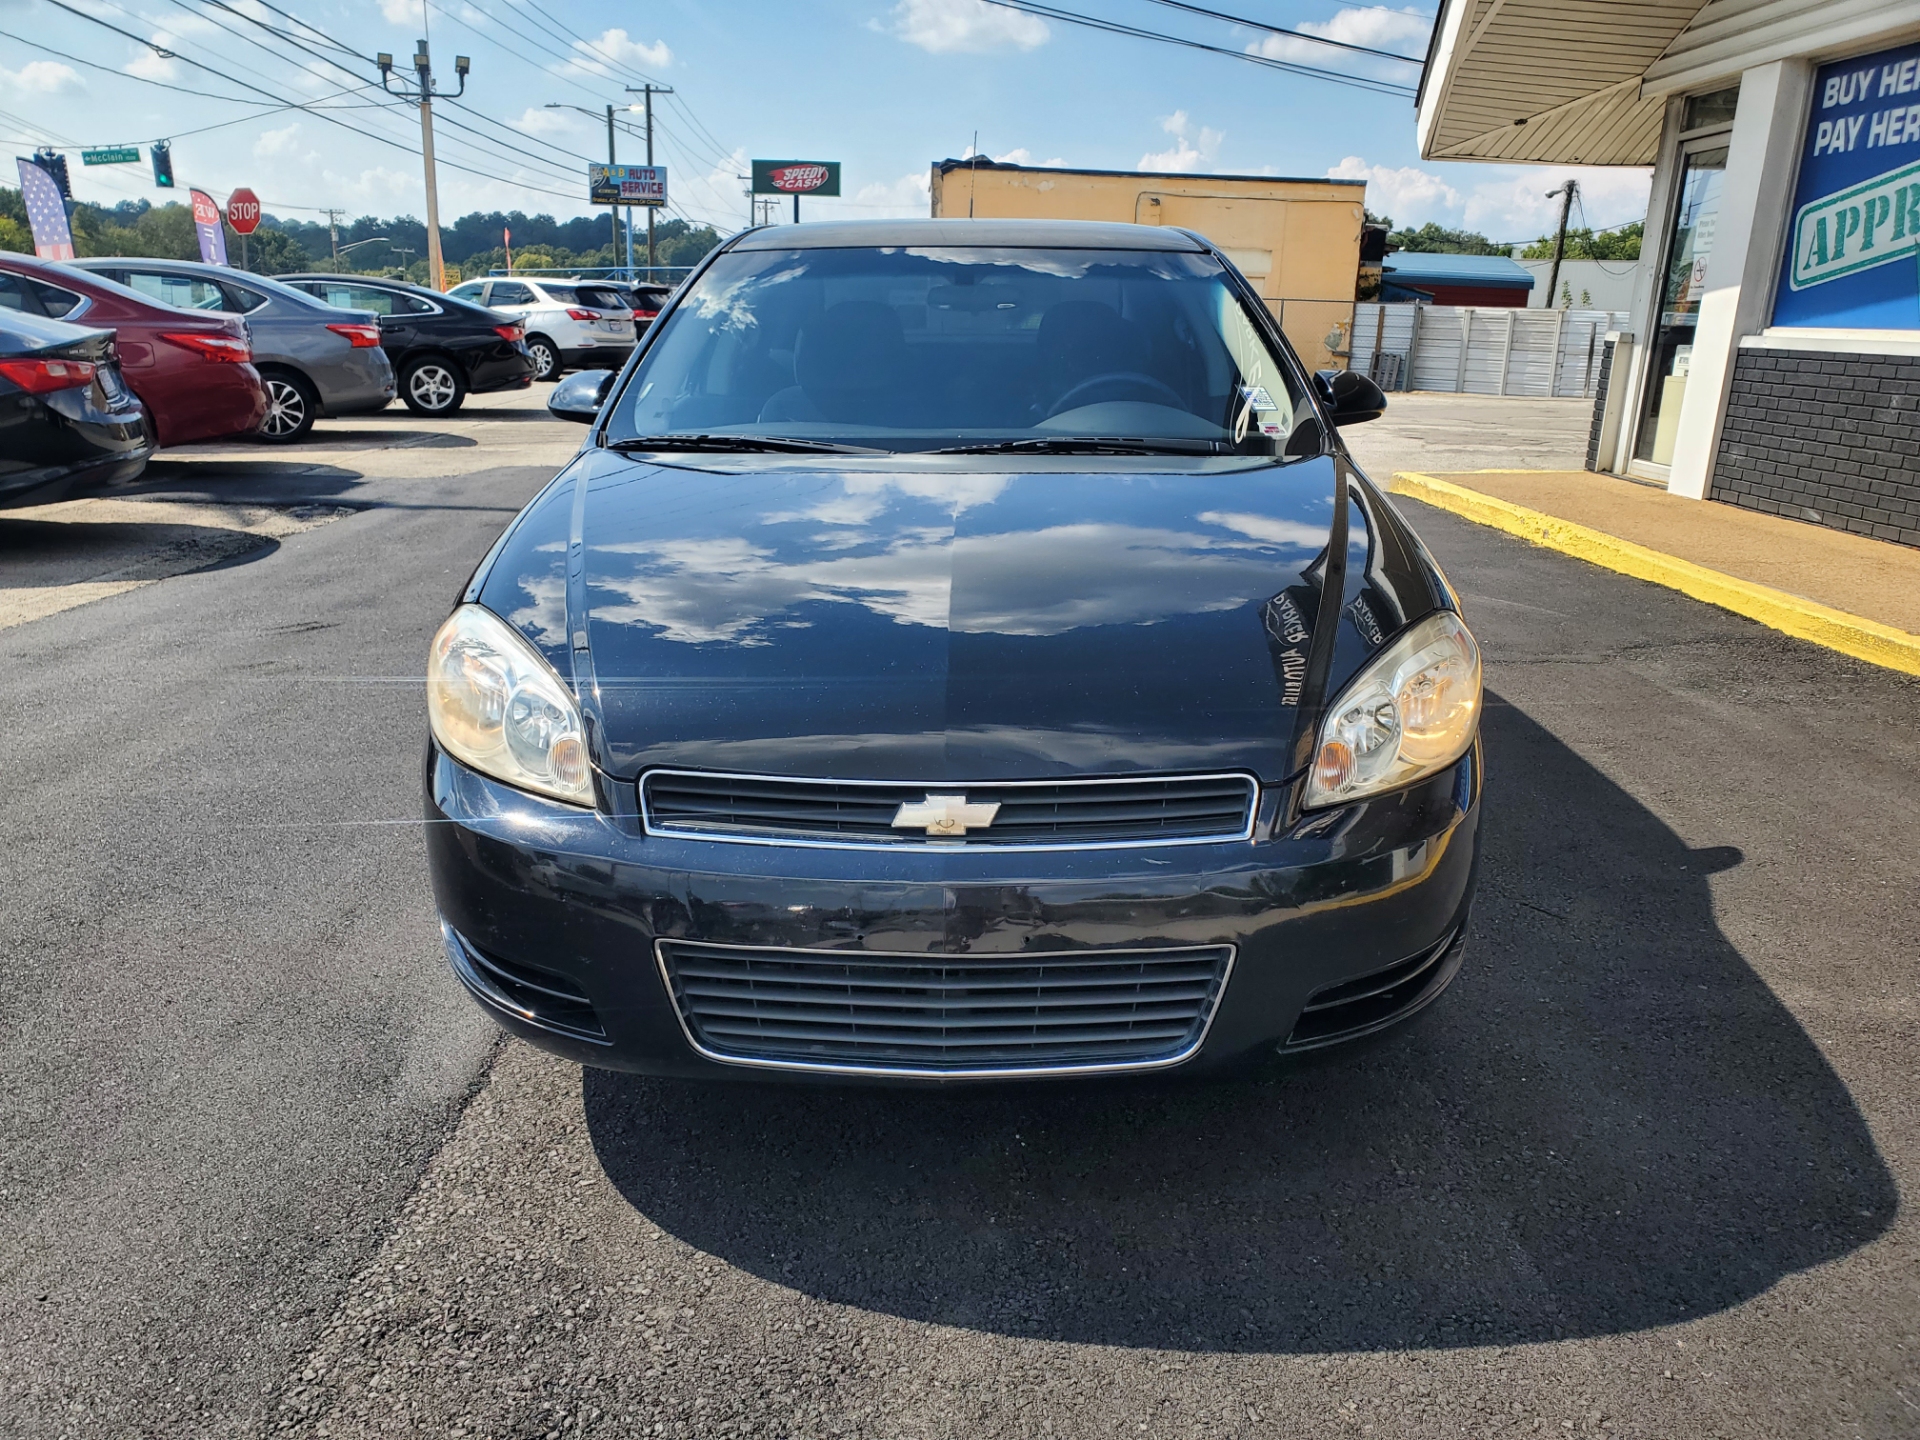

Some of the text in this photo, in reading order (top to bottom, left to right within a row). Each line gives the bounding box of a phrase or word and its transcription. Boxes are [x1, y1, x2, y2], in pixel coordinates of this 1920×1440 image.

[1822, 68, 1876, 109] BUY
[1813, 114, 1866, 157] PAY
[91, 153, 123, 163] McClain
[603, 167, 610, 177] A
[618, 168, 625, 178] B
[629, 168, 656, 180] AUTO
[783, 167, 826, 181] SPEEDY
[621, 181, 663, 194] SERVICE
[230, 202, 258, 220] STOP
